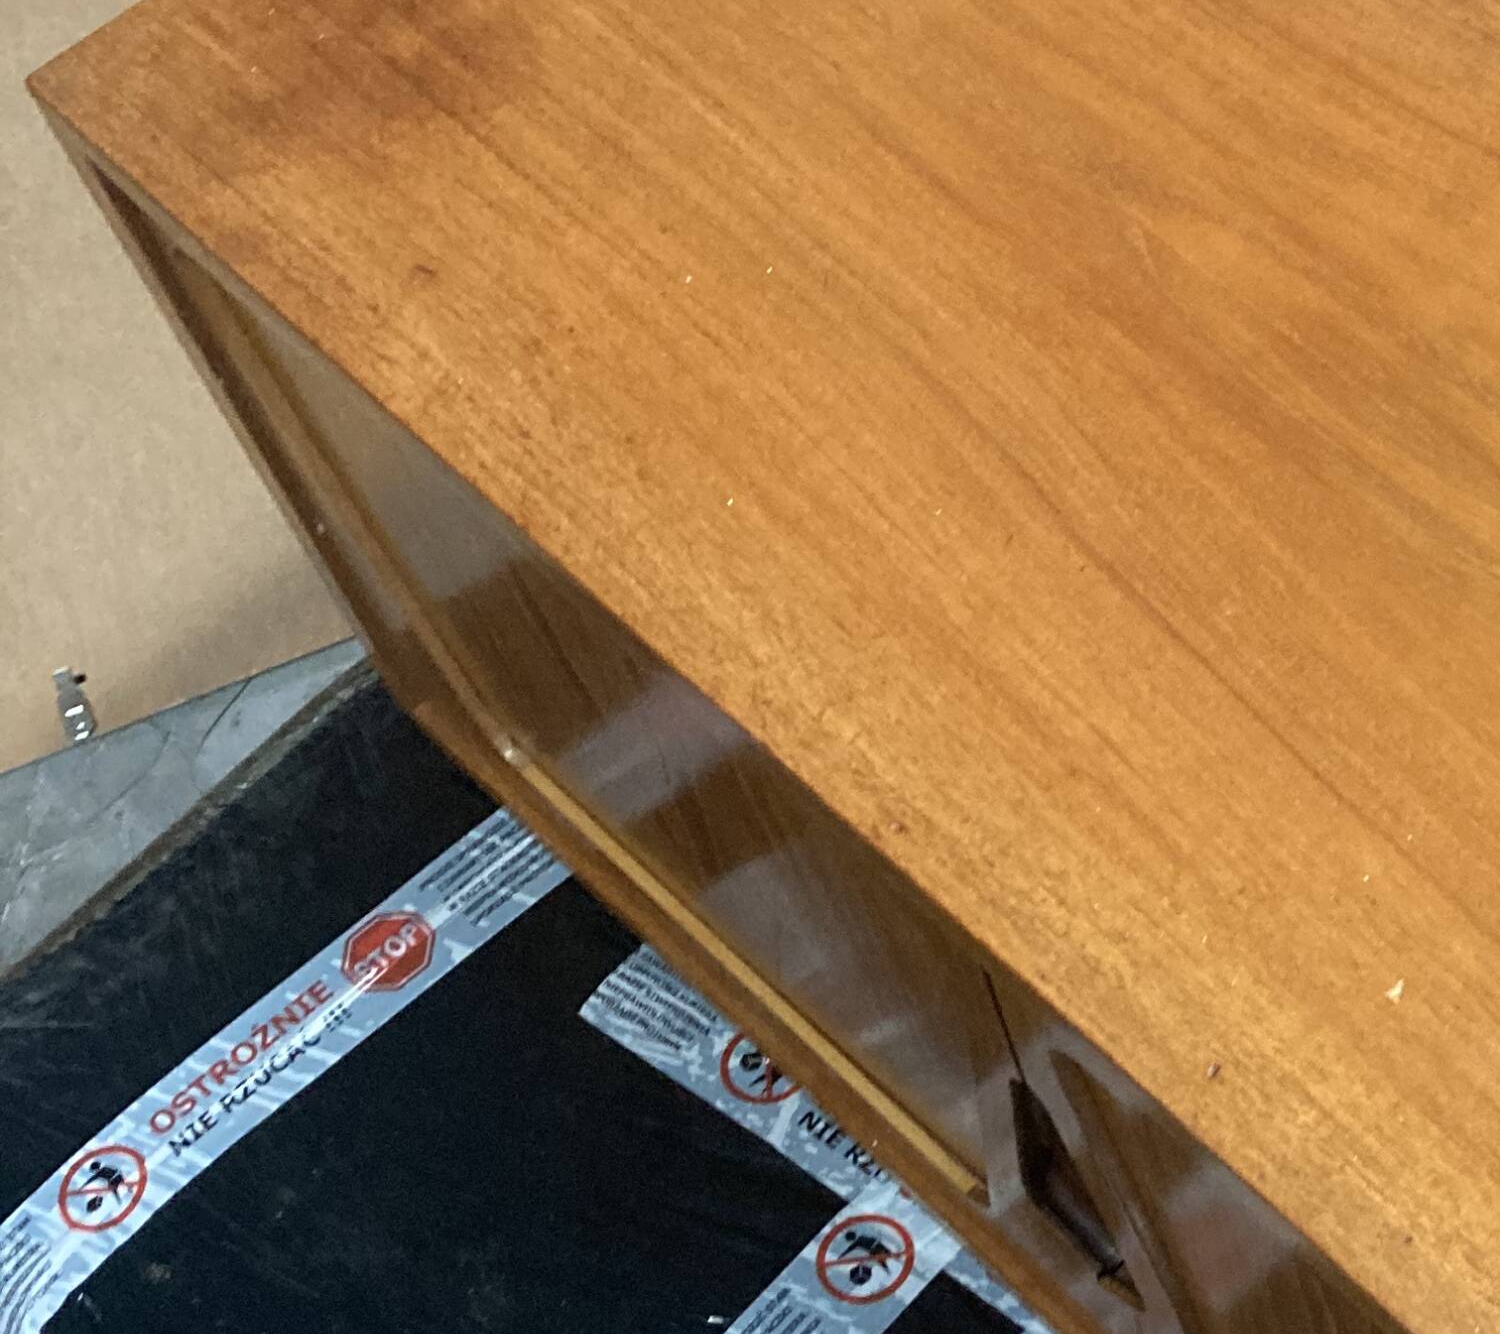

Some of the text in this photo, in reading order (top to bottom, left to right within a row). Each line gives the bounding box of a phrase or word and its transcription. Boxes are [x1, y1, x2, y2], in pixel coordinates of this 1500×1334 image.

[150, 980, 335, 1135] OSTROŻNIE
[168, 1114, 217, 1157] NIE
[800, 1110, 844, 1157] NIE
